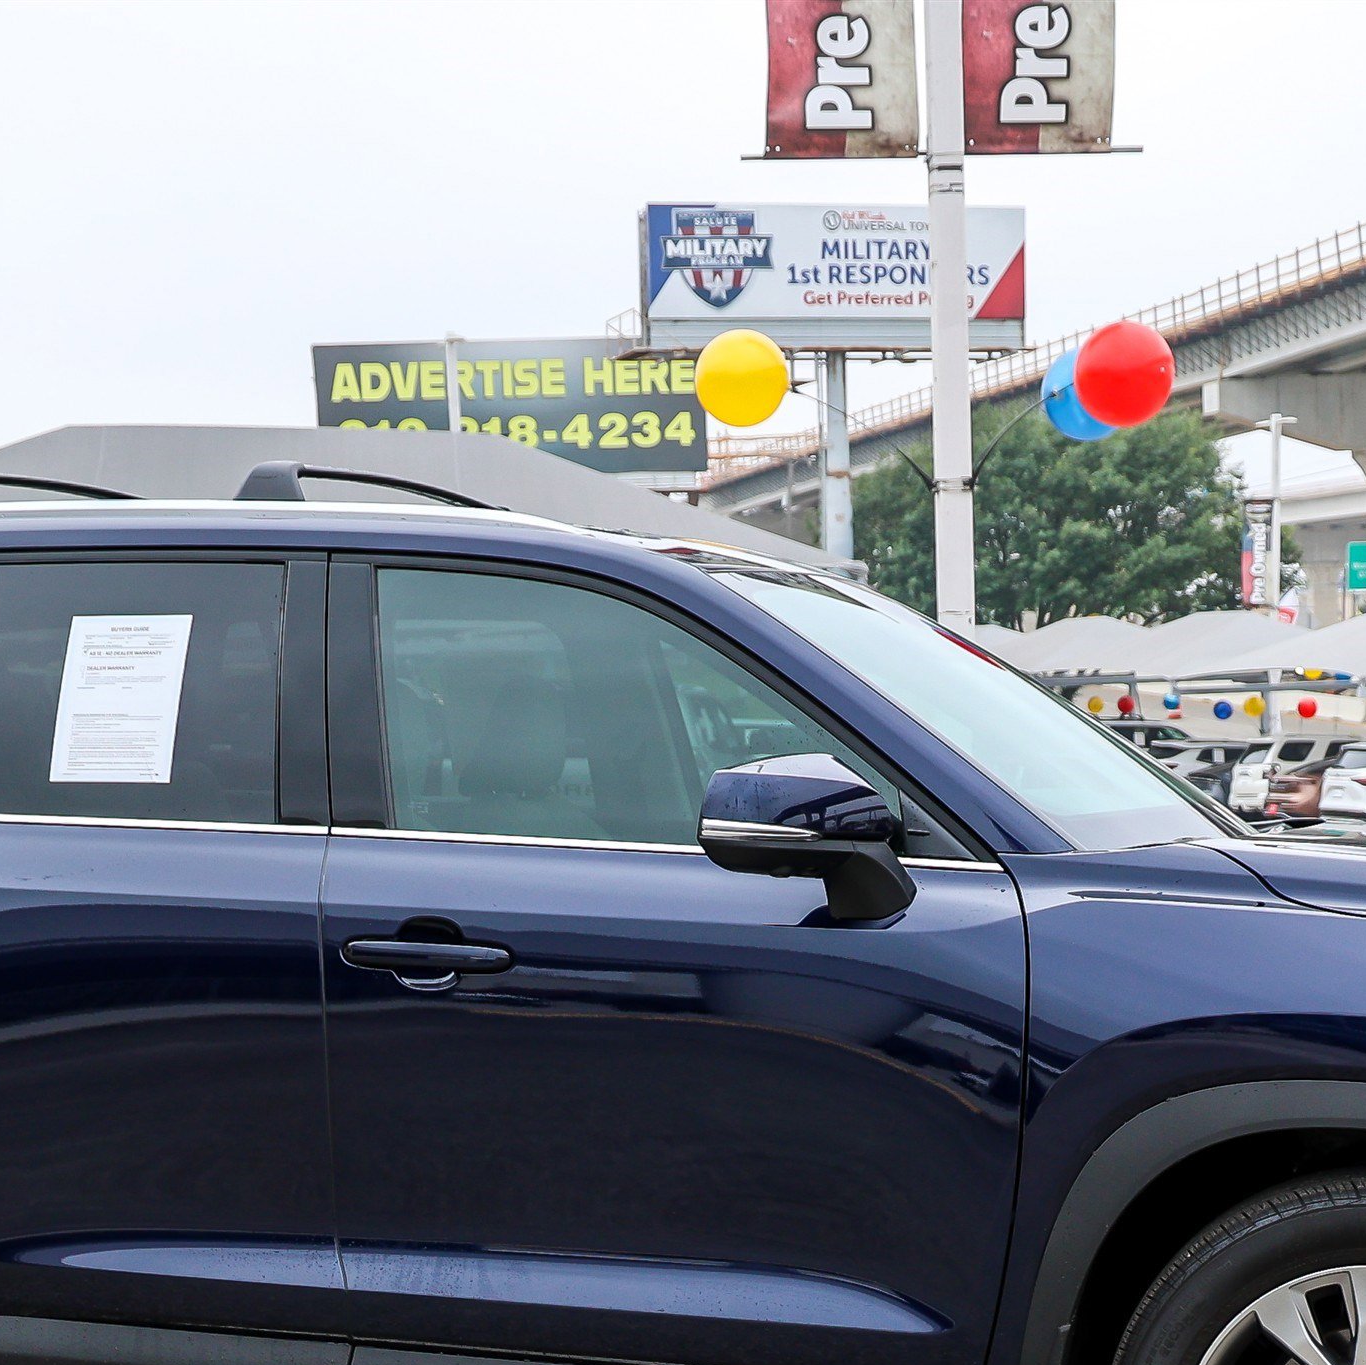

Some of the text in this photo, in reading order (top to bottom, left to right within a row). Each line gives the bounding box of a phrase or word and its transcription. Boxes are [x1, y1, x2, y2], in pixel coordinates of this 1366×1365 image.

[805, 14, 875, 130] Pre
[999, 4, 1071, 125] Pre
[694, 216, 737, 226] SALUTE
[909, 221, 930, 231] TOY
[665, 238, 767, 259] MILITARY
[787, 263, 990, 285] 1st RESPONRS
[803, 291, 832, 306] Get
[837, 290, 914, 306] Preferred
[331, 356, 697, 402] ADVERTISE HERE
